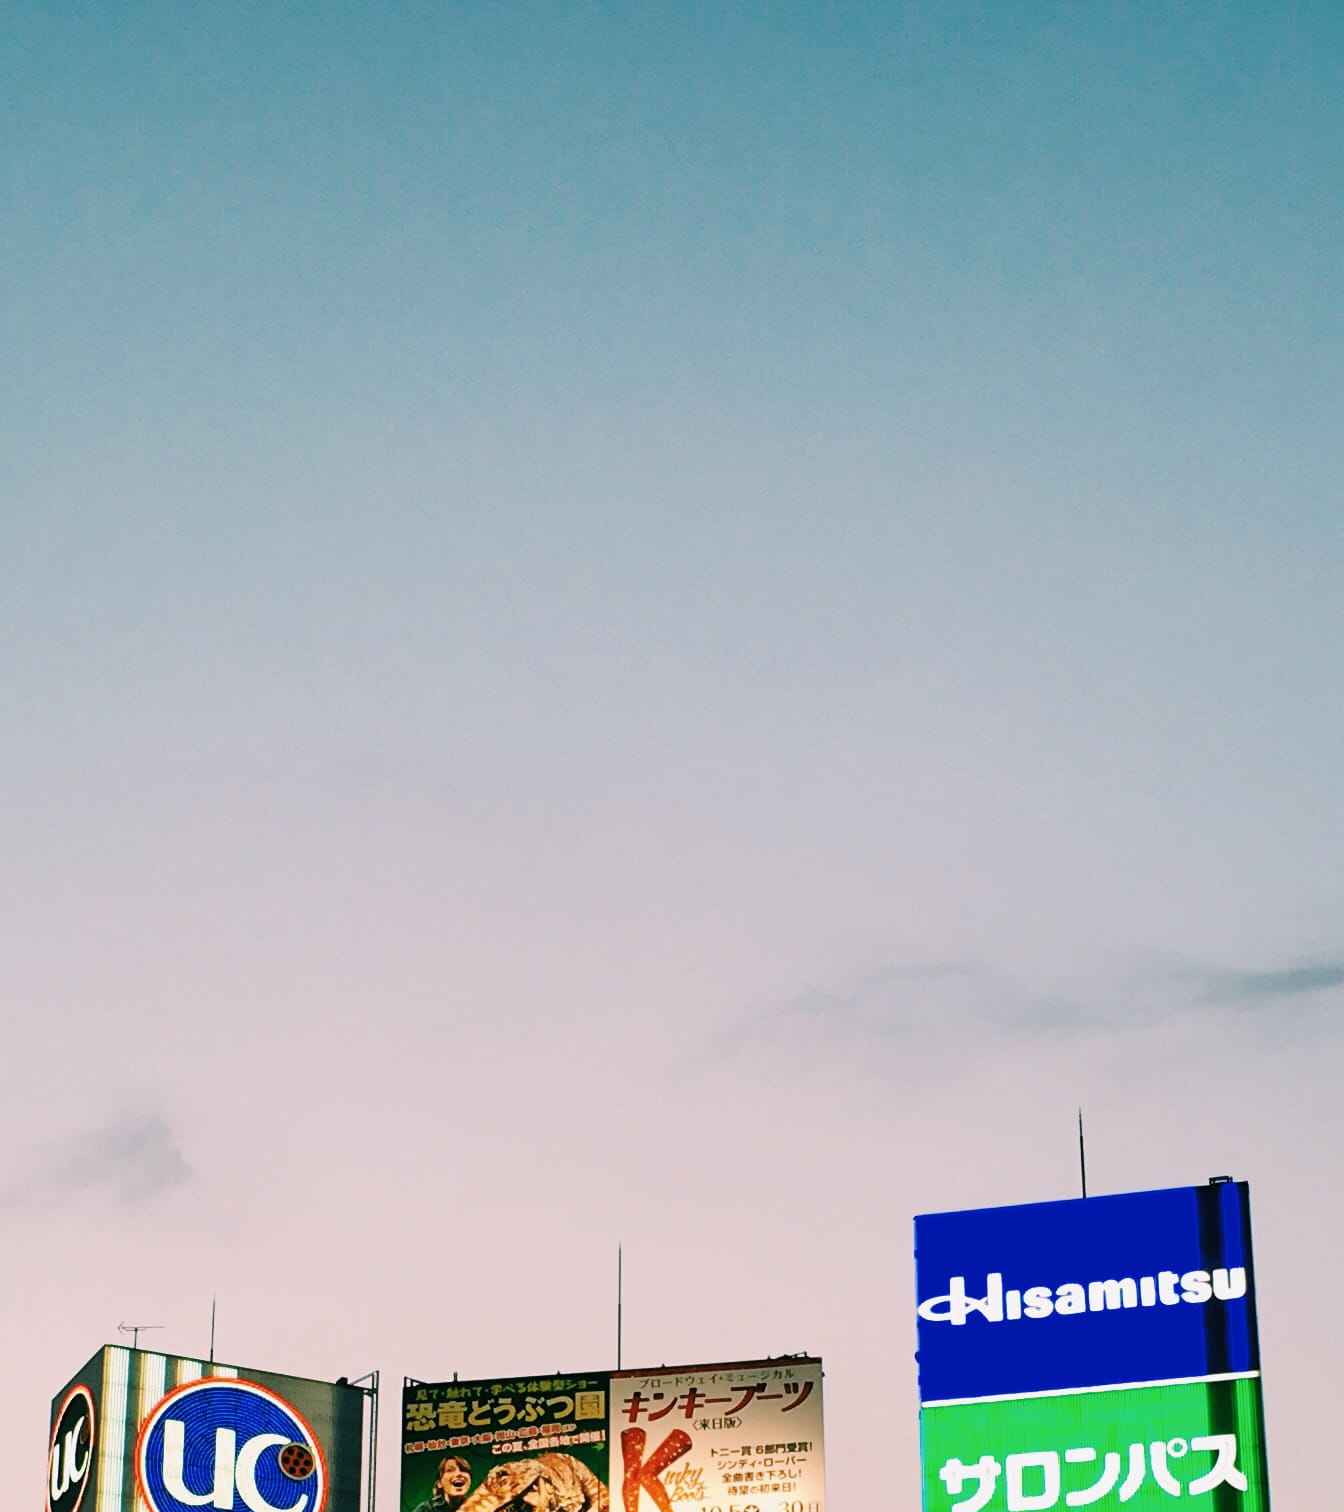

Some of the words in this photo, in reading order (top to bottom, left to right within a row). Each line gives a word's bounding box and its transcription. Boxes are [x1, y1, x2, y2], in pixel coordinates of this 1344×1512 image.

[918, 1267, 1247, 1326] Hisamitsu
[639, 1371, 795, 1389] ブロードウェイ・ミュージカル
[406, 1390, 606, 1432] 恐竜どうぶつ園
[621, 1381, 814, 1423] キンキーブーツ
